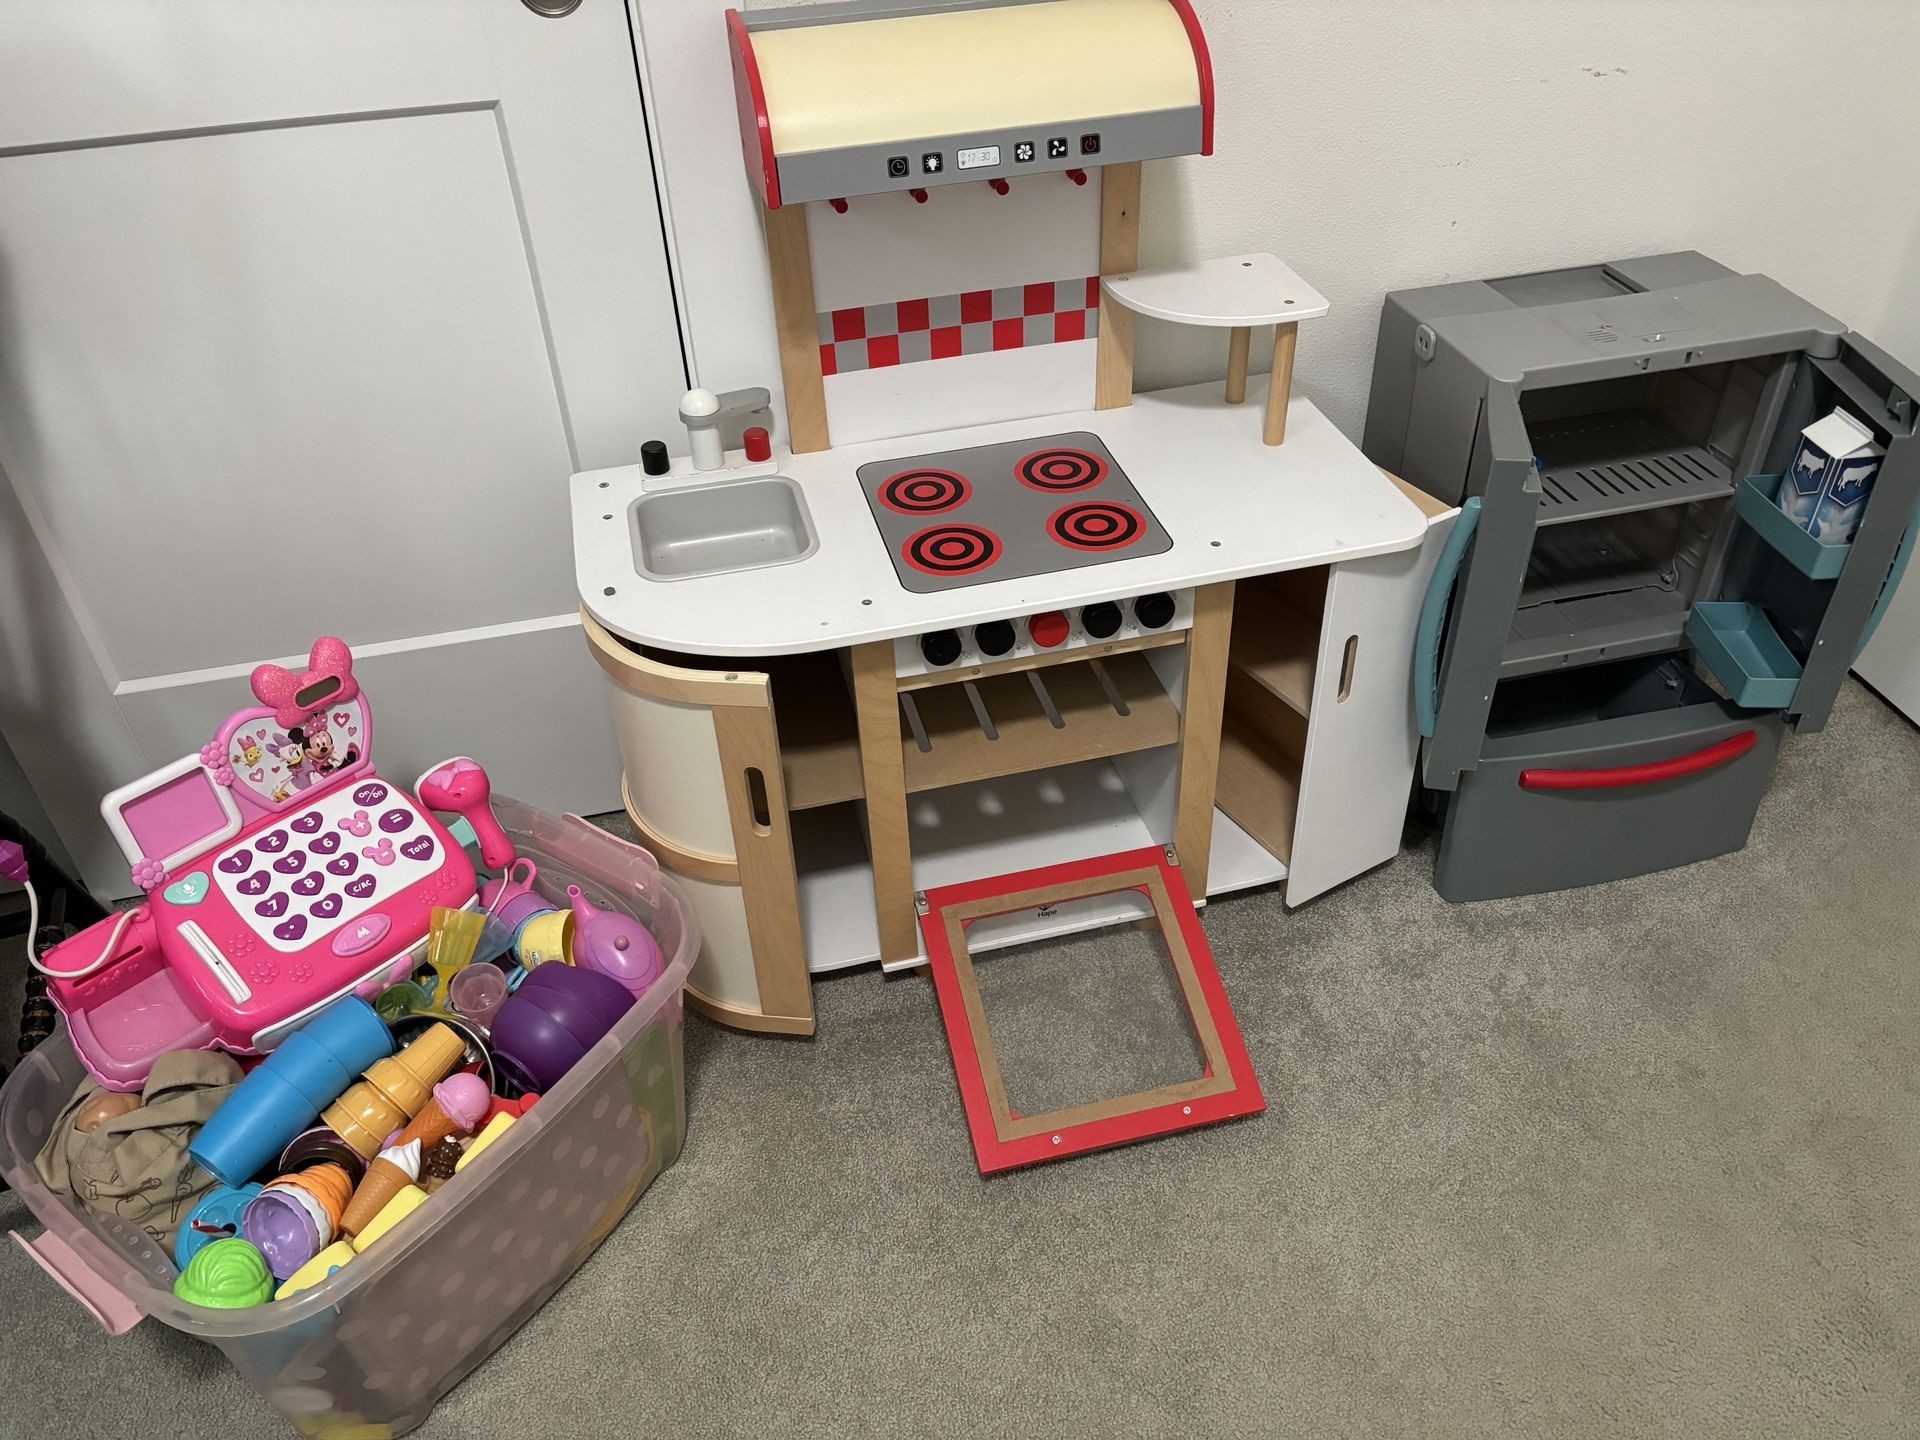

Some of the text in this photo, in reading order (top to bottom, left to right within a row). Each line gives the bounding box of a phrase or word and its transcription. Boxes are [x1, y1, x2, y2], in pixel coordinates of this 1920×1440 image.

[358, 786, 384, 802] On/Off
[303, 817, 315, 827] 3
[267, 836, 280, 847] 2
[322, 837, 333, 848] 6
[407, 840, 430, 855] Total
[231, 857, 242, 867] 1
[286, 856, 299, 867] 5
[338, 859, 350, 870] 9
[249, 878, 261, 889] 4
[303, 878, 316, 888] 8
[352, 879, 372, 892] C/AC
[267, 898, 278, 911] 7
[321, 900, 334, 911] 0
[1037, 909, 1058, 918] Hape
[356, 926, 370, 938] M
